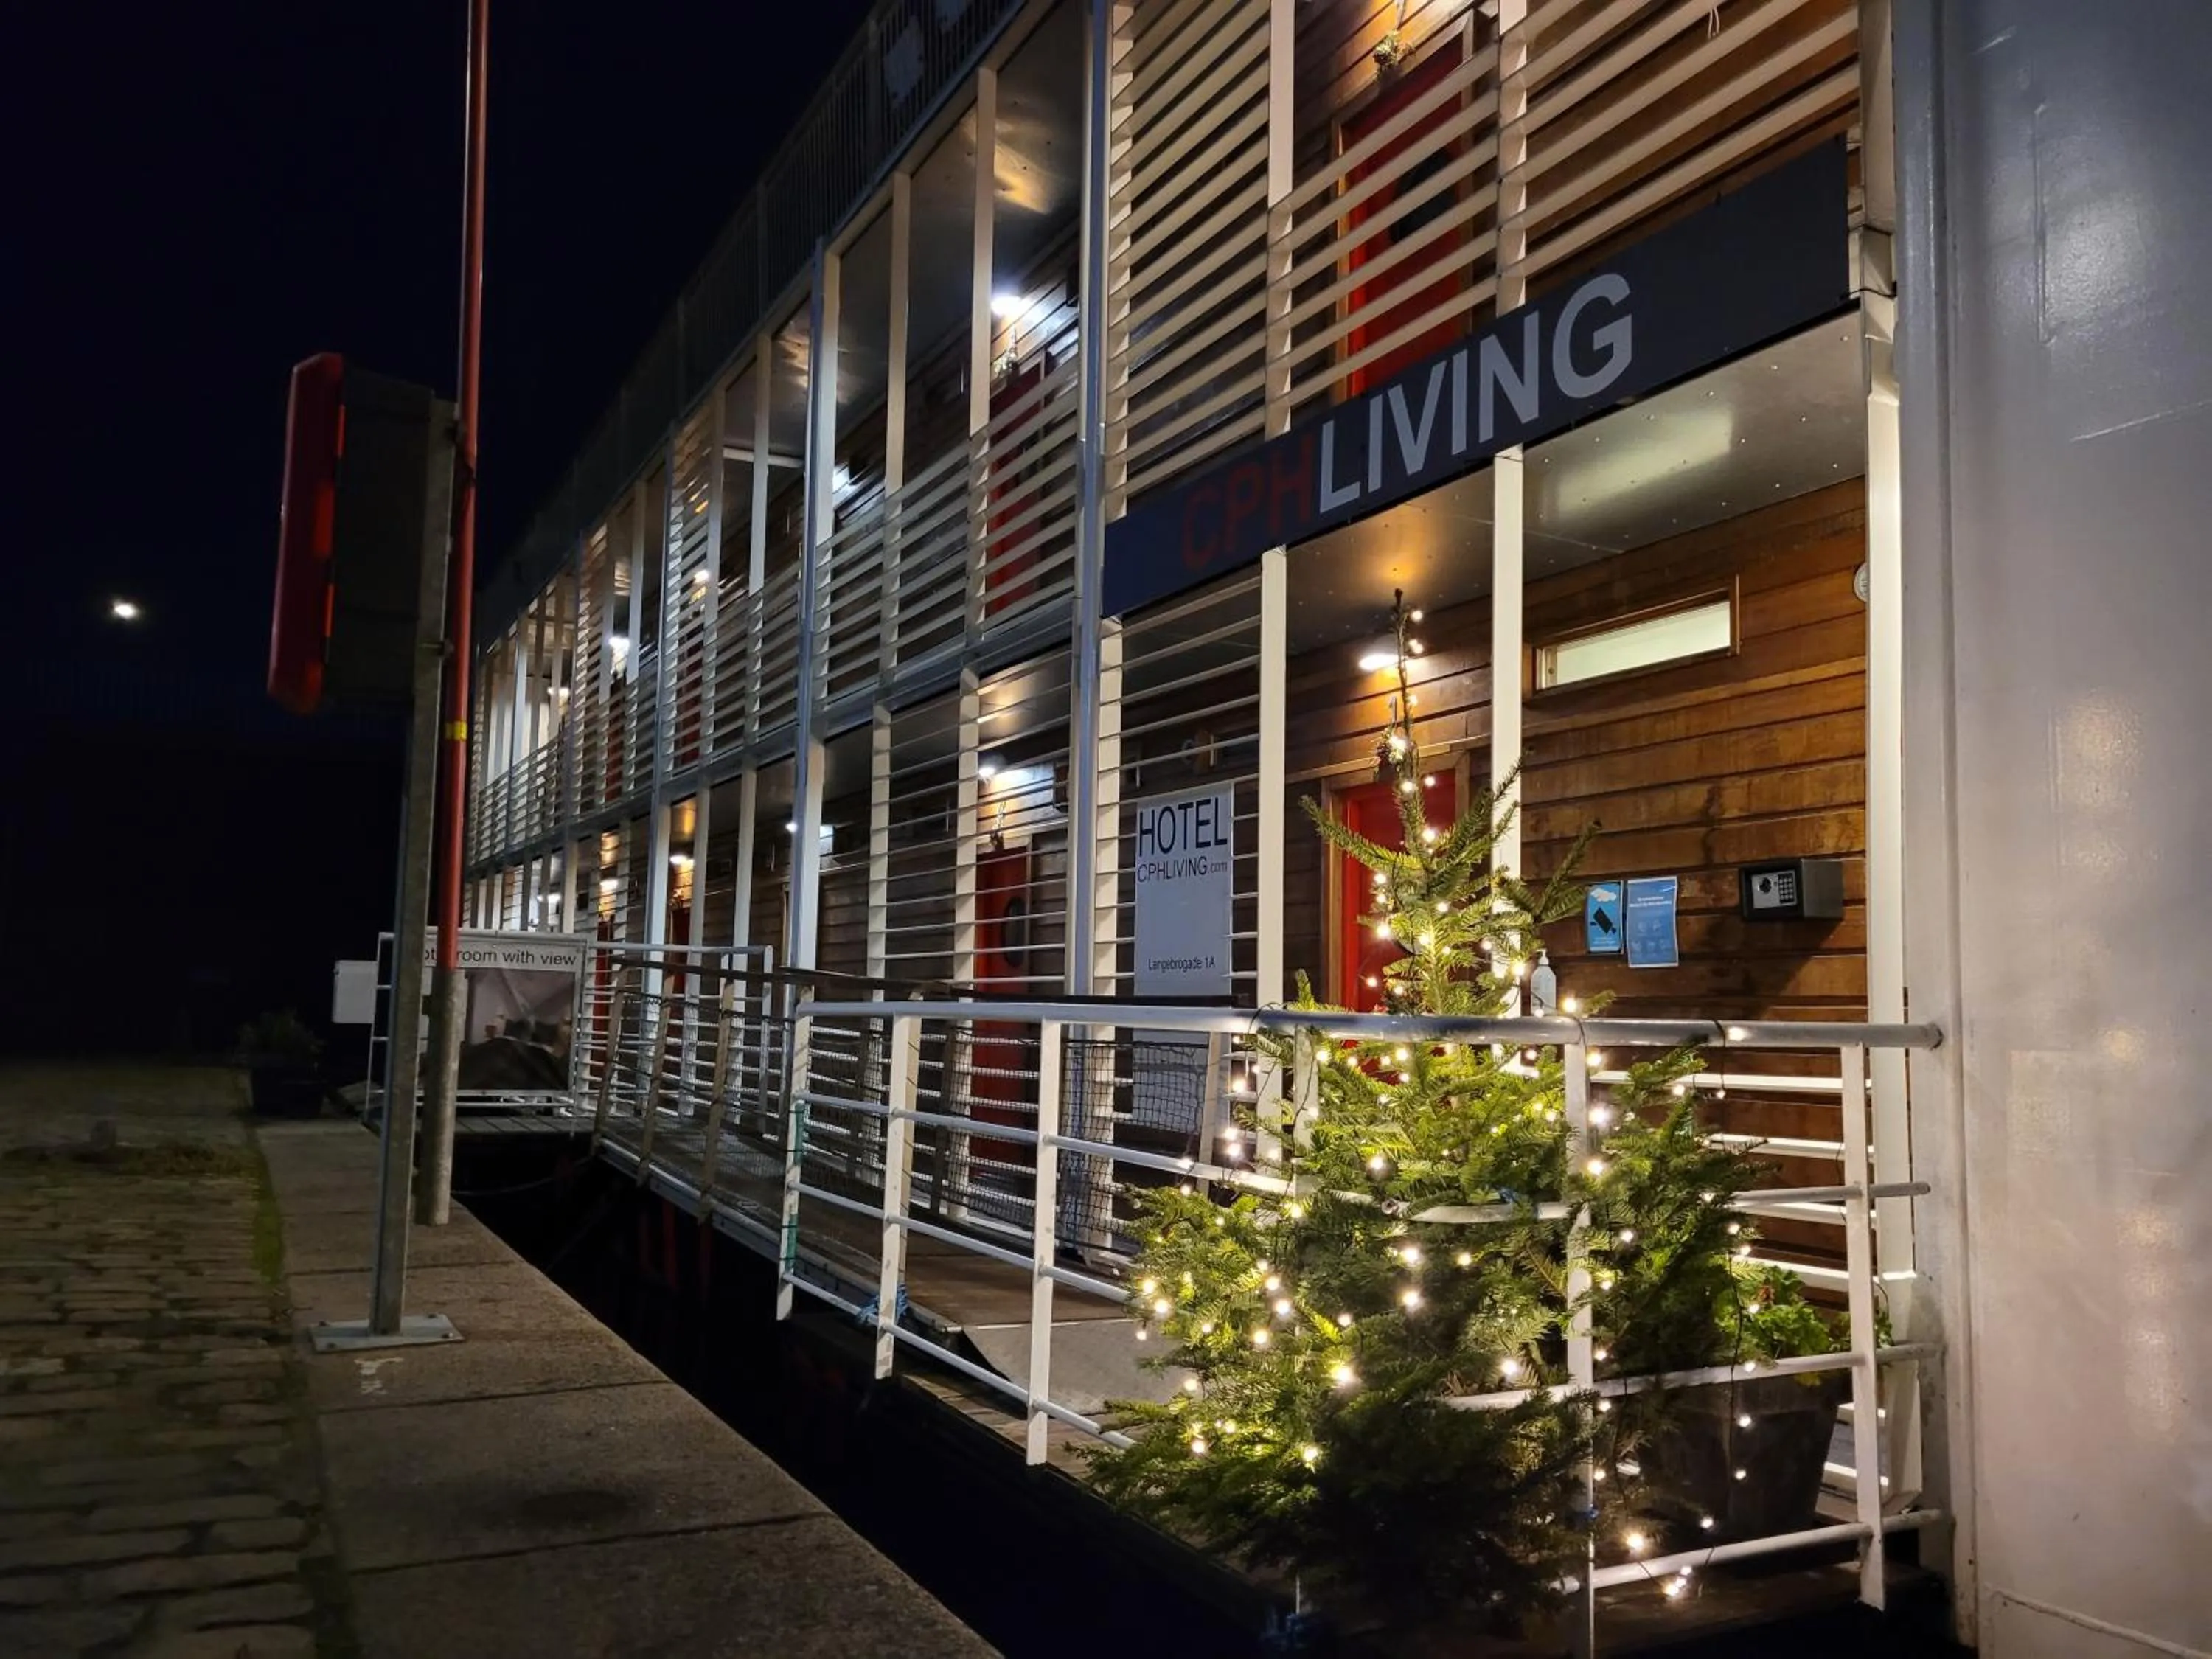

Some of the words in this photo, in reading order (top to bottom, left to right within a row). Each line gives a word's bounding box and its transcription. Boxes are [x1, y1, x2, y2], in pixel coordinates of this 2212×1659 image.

[1138, 797, 1228, 857] HOTEL
[456, 950, 497, 962] room
[503, 949, 535, 961] with
[540, 953, 577, 966] view
[1205, 956, 1215, 969] 1A
